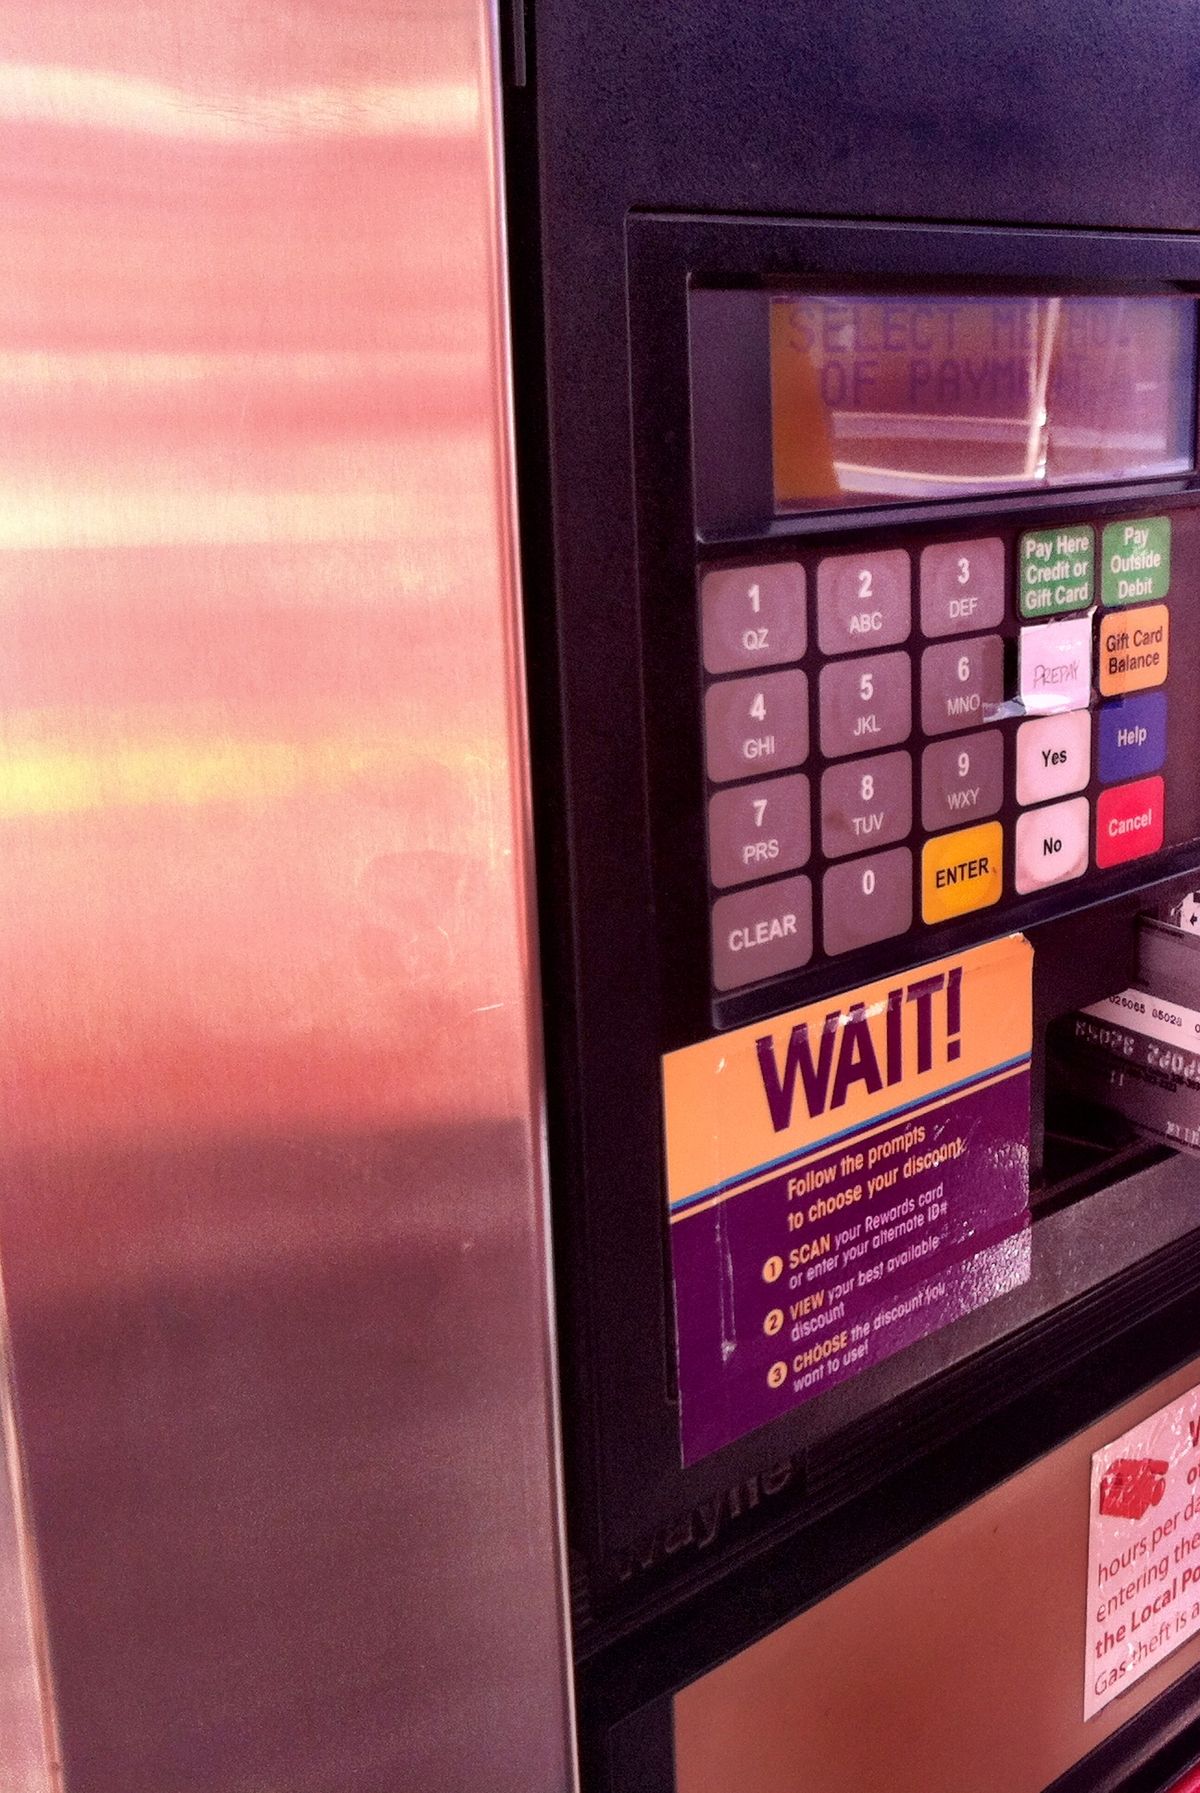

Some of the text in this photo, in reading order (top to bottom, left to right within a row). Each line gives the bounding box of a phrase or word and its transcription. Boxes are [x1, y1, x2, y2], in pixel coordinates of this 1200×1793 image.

[821, 359, 877, 409] OF
[1025, 535, 1090, 562] Pay Here
[1124, 525, 1149, 547] Pay
[957, 557, 970, 585] 3
[1026, 561, 1089, 585] Credit or
[1110, 550, 1162, 575] Outside
[748, 583, 762, 614] 1
[858, 570, 873, 600] 2
[1025, 582, 1089, 610] Gift Card
[1117, 577, 1153, 600] Debit
[948, 597, 979, 619] DEF
[848, 612, 883, 634] ABC
[742, 629, 770, 651] QZ
[1105, 625, 1163, 653] Gift Card
[956, 656, 970, 683] 6
[1108, 651, 1161, 676] Balance
[859, 673, 874, 702] 5
[748, 692, 767, 722] 4
[946, 693, 981, 718] MNO
[853, 714, 881, 737] JKL
[1116, 726, 1149, 750] Help
[742, 735, 775, 761] GHI
[1040, 747, 1068, 769] Yes
[957, 751, 970, 778] 9
[860, 774, 874, 802] 8
[947, 786, 981, 810] WXY
[752, 798, 769, 828] 7
[852, 812, 885, 837] TUV
[1107, 807, 1153, 838] Cancel
[742, 838, 780, 865] PRS
[1042, 836, 1063, 858] No
[861, 868, 876, 896] 0
[934, 857, 991, 890] ENTER
[727, 912, 798, 953] CLEAR
[755, 965, 964, 1134] WAIT!
[787, 1124, 927, 1201] Follow the prompts
[787, 1210, 805, 1233] to
[808, 1184, 863, 1223] choose
[867, 1166, 899, 1200] your
[788, 1182, 944, 1271] SCAN your Rewards card
[788, 1201, 949, 1291] or enter your alternate ID#
[789, 1235, 941, 1321] VIEW your best available
[790, 1301, 846, 1343] discount
[792, 1330, 849, 1373] CHOOSE
[850, 1319, 871, 1342] the
[873, 1292, 924, 1331] discount
[792, 1364, 825, 1393] want
[826, 1356, 841, 1374] to
[1097, 1538, 1148, 1587] hours
[1151, 1516, 1181, 1552] per
[1096, 1554, 1170, 1624] entering
[1173, 1530, 1200, 1565] the
[1094, 1622, 1126, 1660] the
[1130, 1576, 1178, 1632] Local
[1094, 1660, 1127, 1697] Gas
[1131, 1622, 1171, 1666] theft
[1174, 1609, 1188, 1632] is
[1190, 1600, 1200, 1620] a
